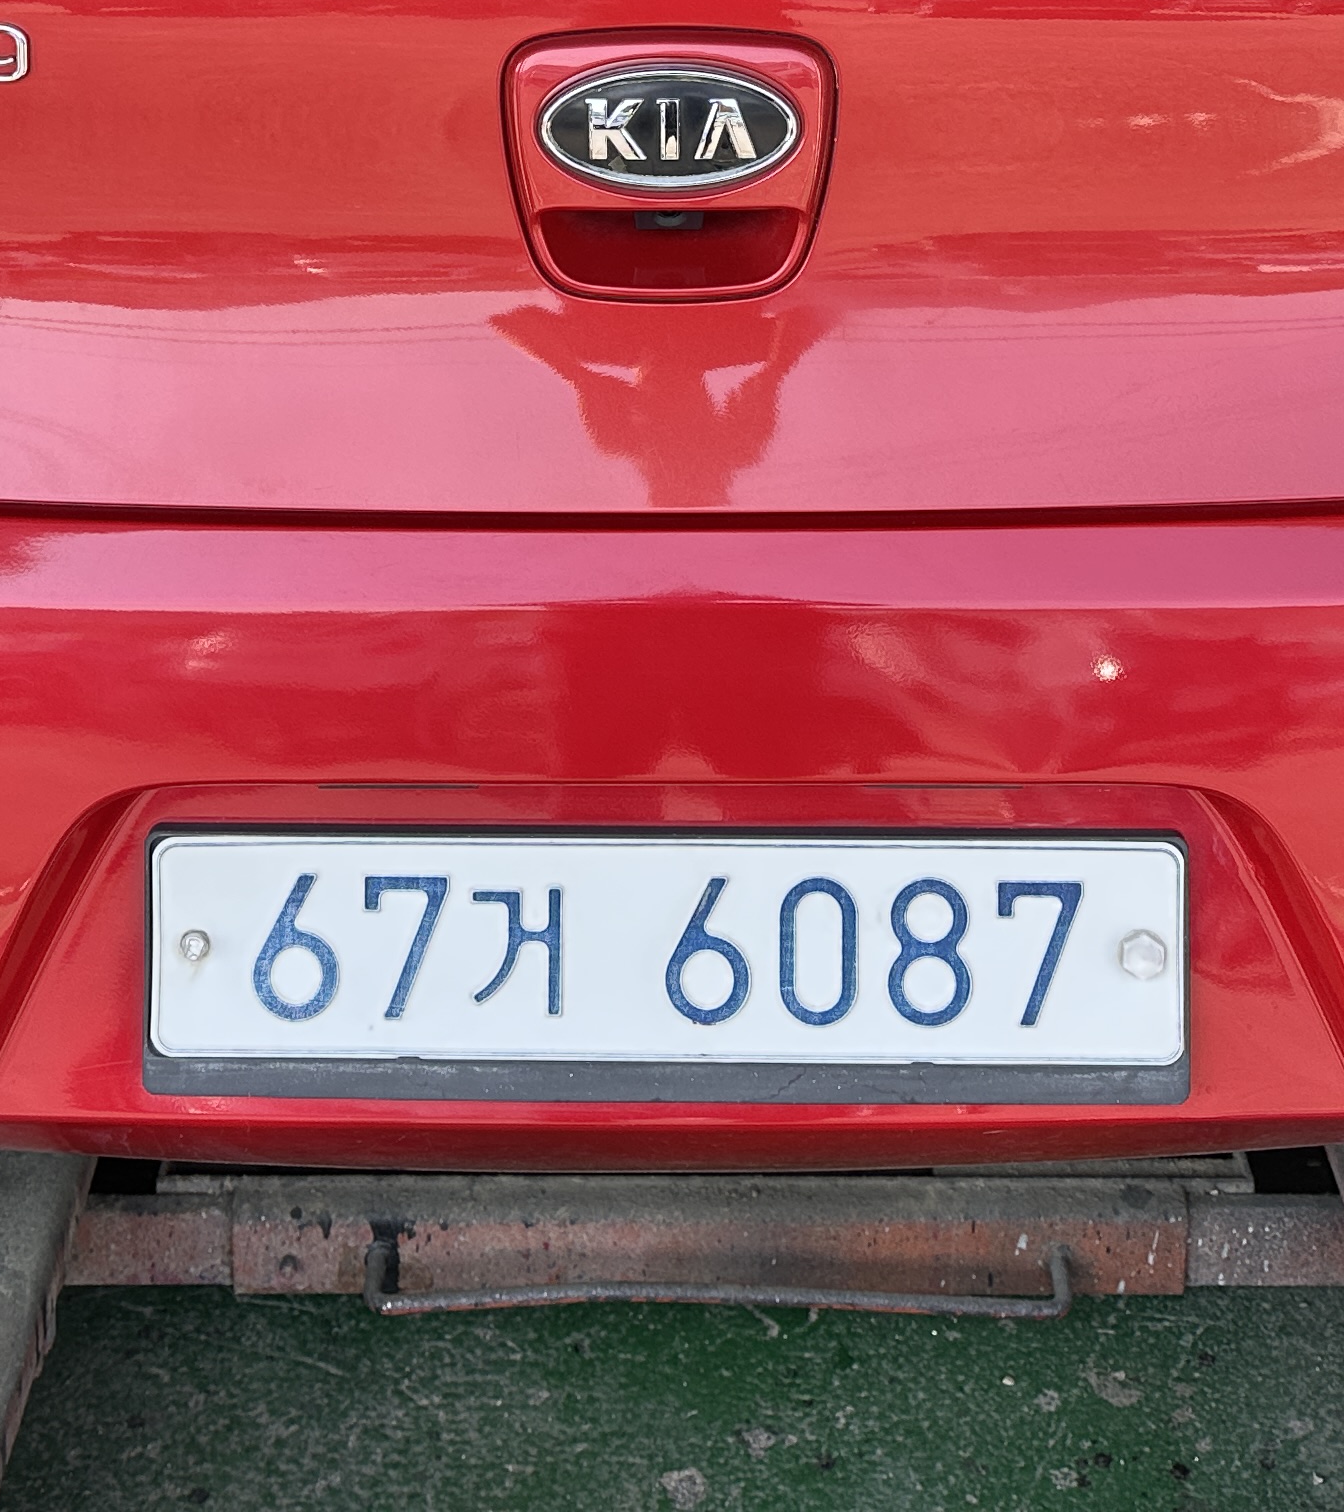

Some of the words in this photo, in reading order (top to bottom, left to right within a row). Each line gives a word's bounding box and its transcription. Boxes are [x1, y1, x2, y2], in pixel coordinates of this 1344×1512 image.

[584, 97, 758, 162] KIA
[251, 872, 564, 1023] 67거
[664, 875, 1085, 1028] 6087
